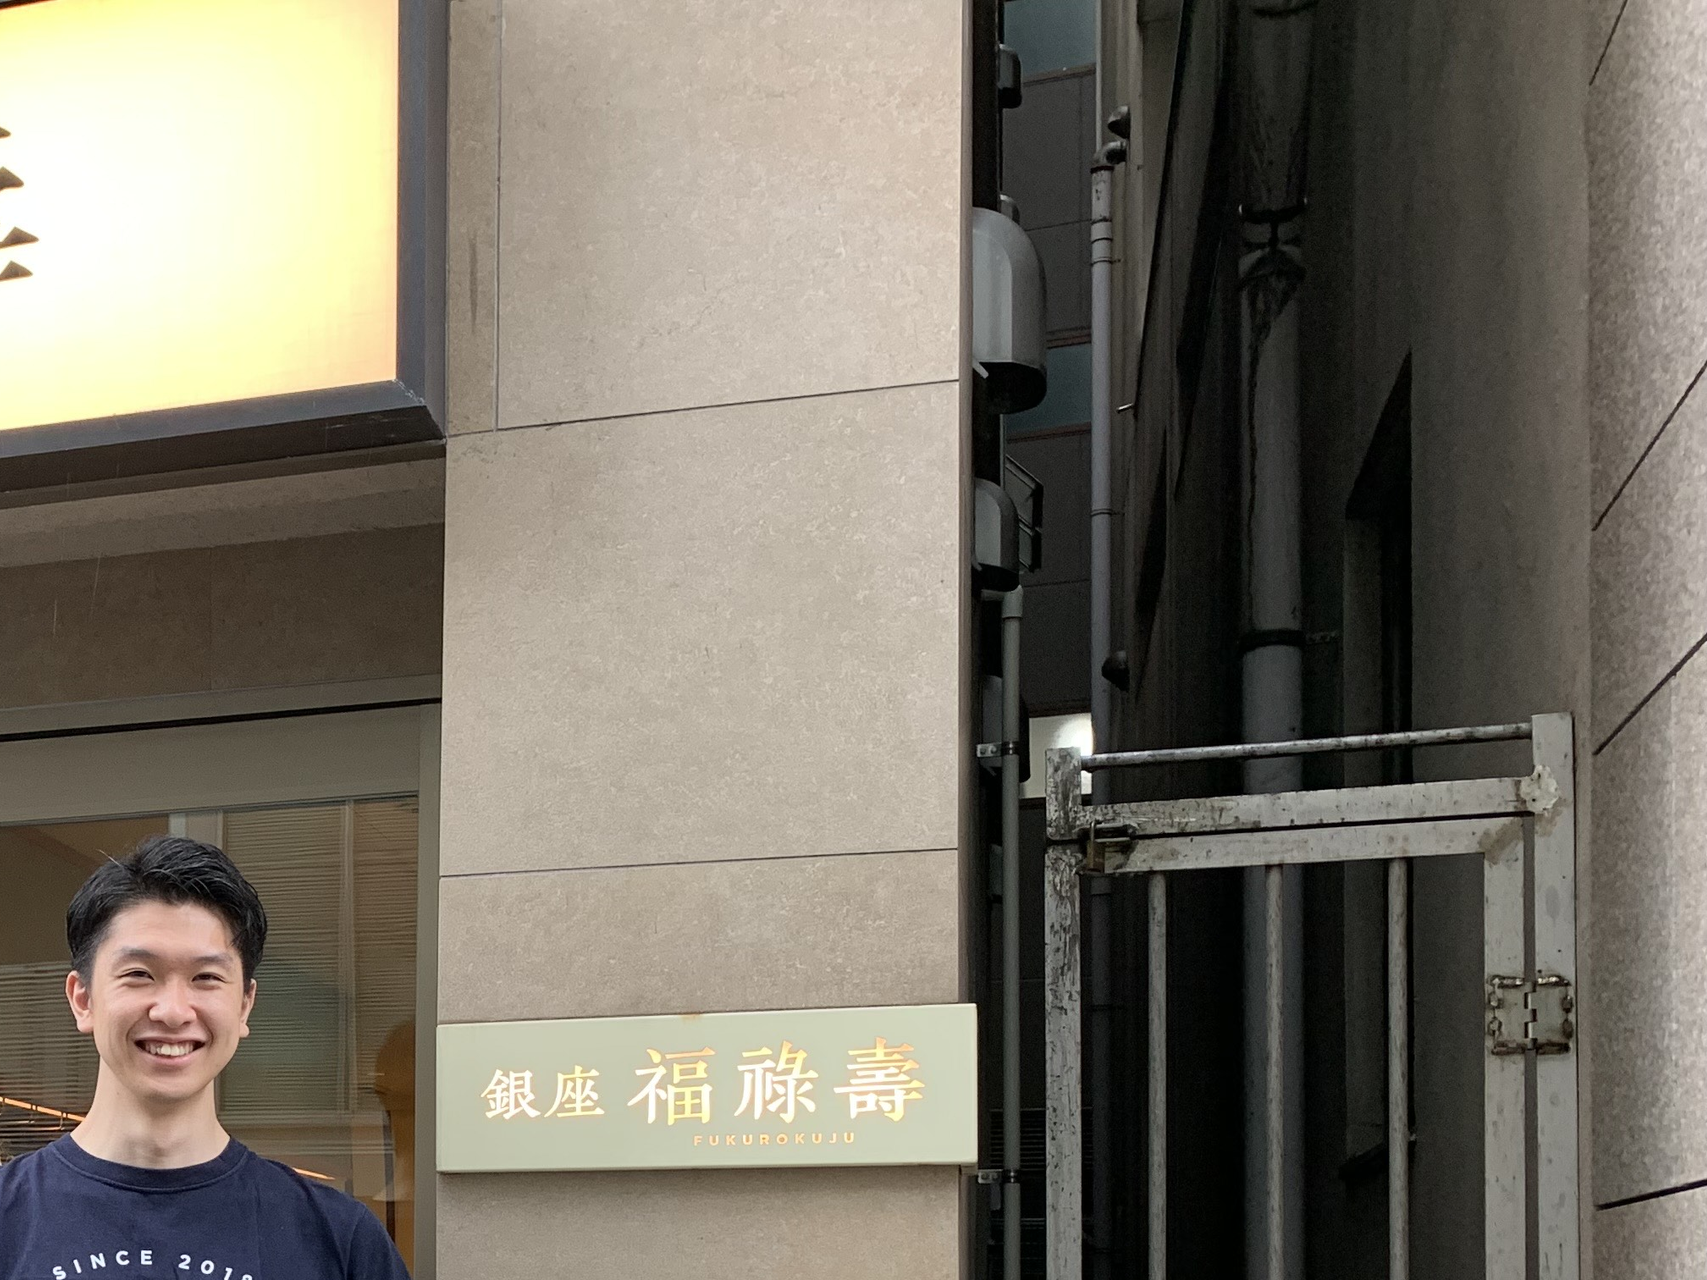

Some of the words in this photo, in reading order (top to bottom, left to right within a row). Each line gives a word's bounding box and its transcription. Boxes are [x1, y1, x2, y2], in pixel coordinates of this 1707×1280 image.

[479, 1064, 606, 1121] 銀座
[692, 1130, 857, 1147] FUKUROKUJU
[52, 1249, 154, 1280] SINCE
